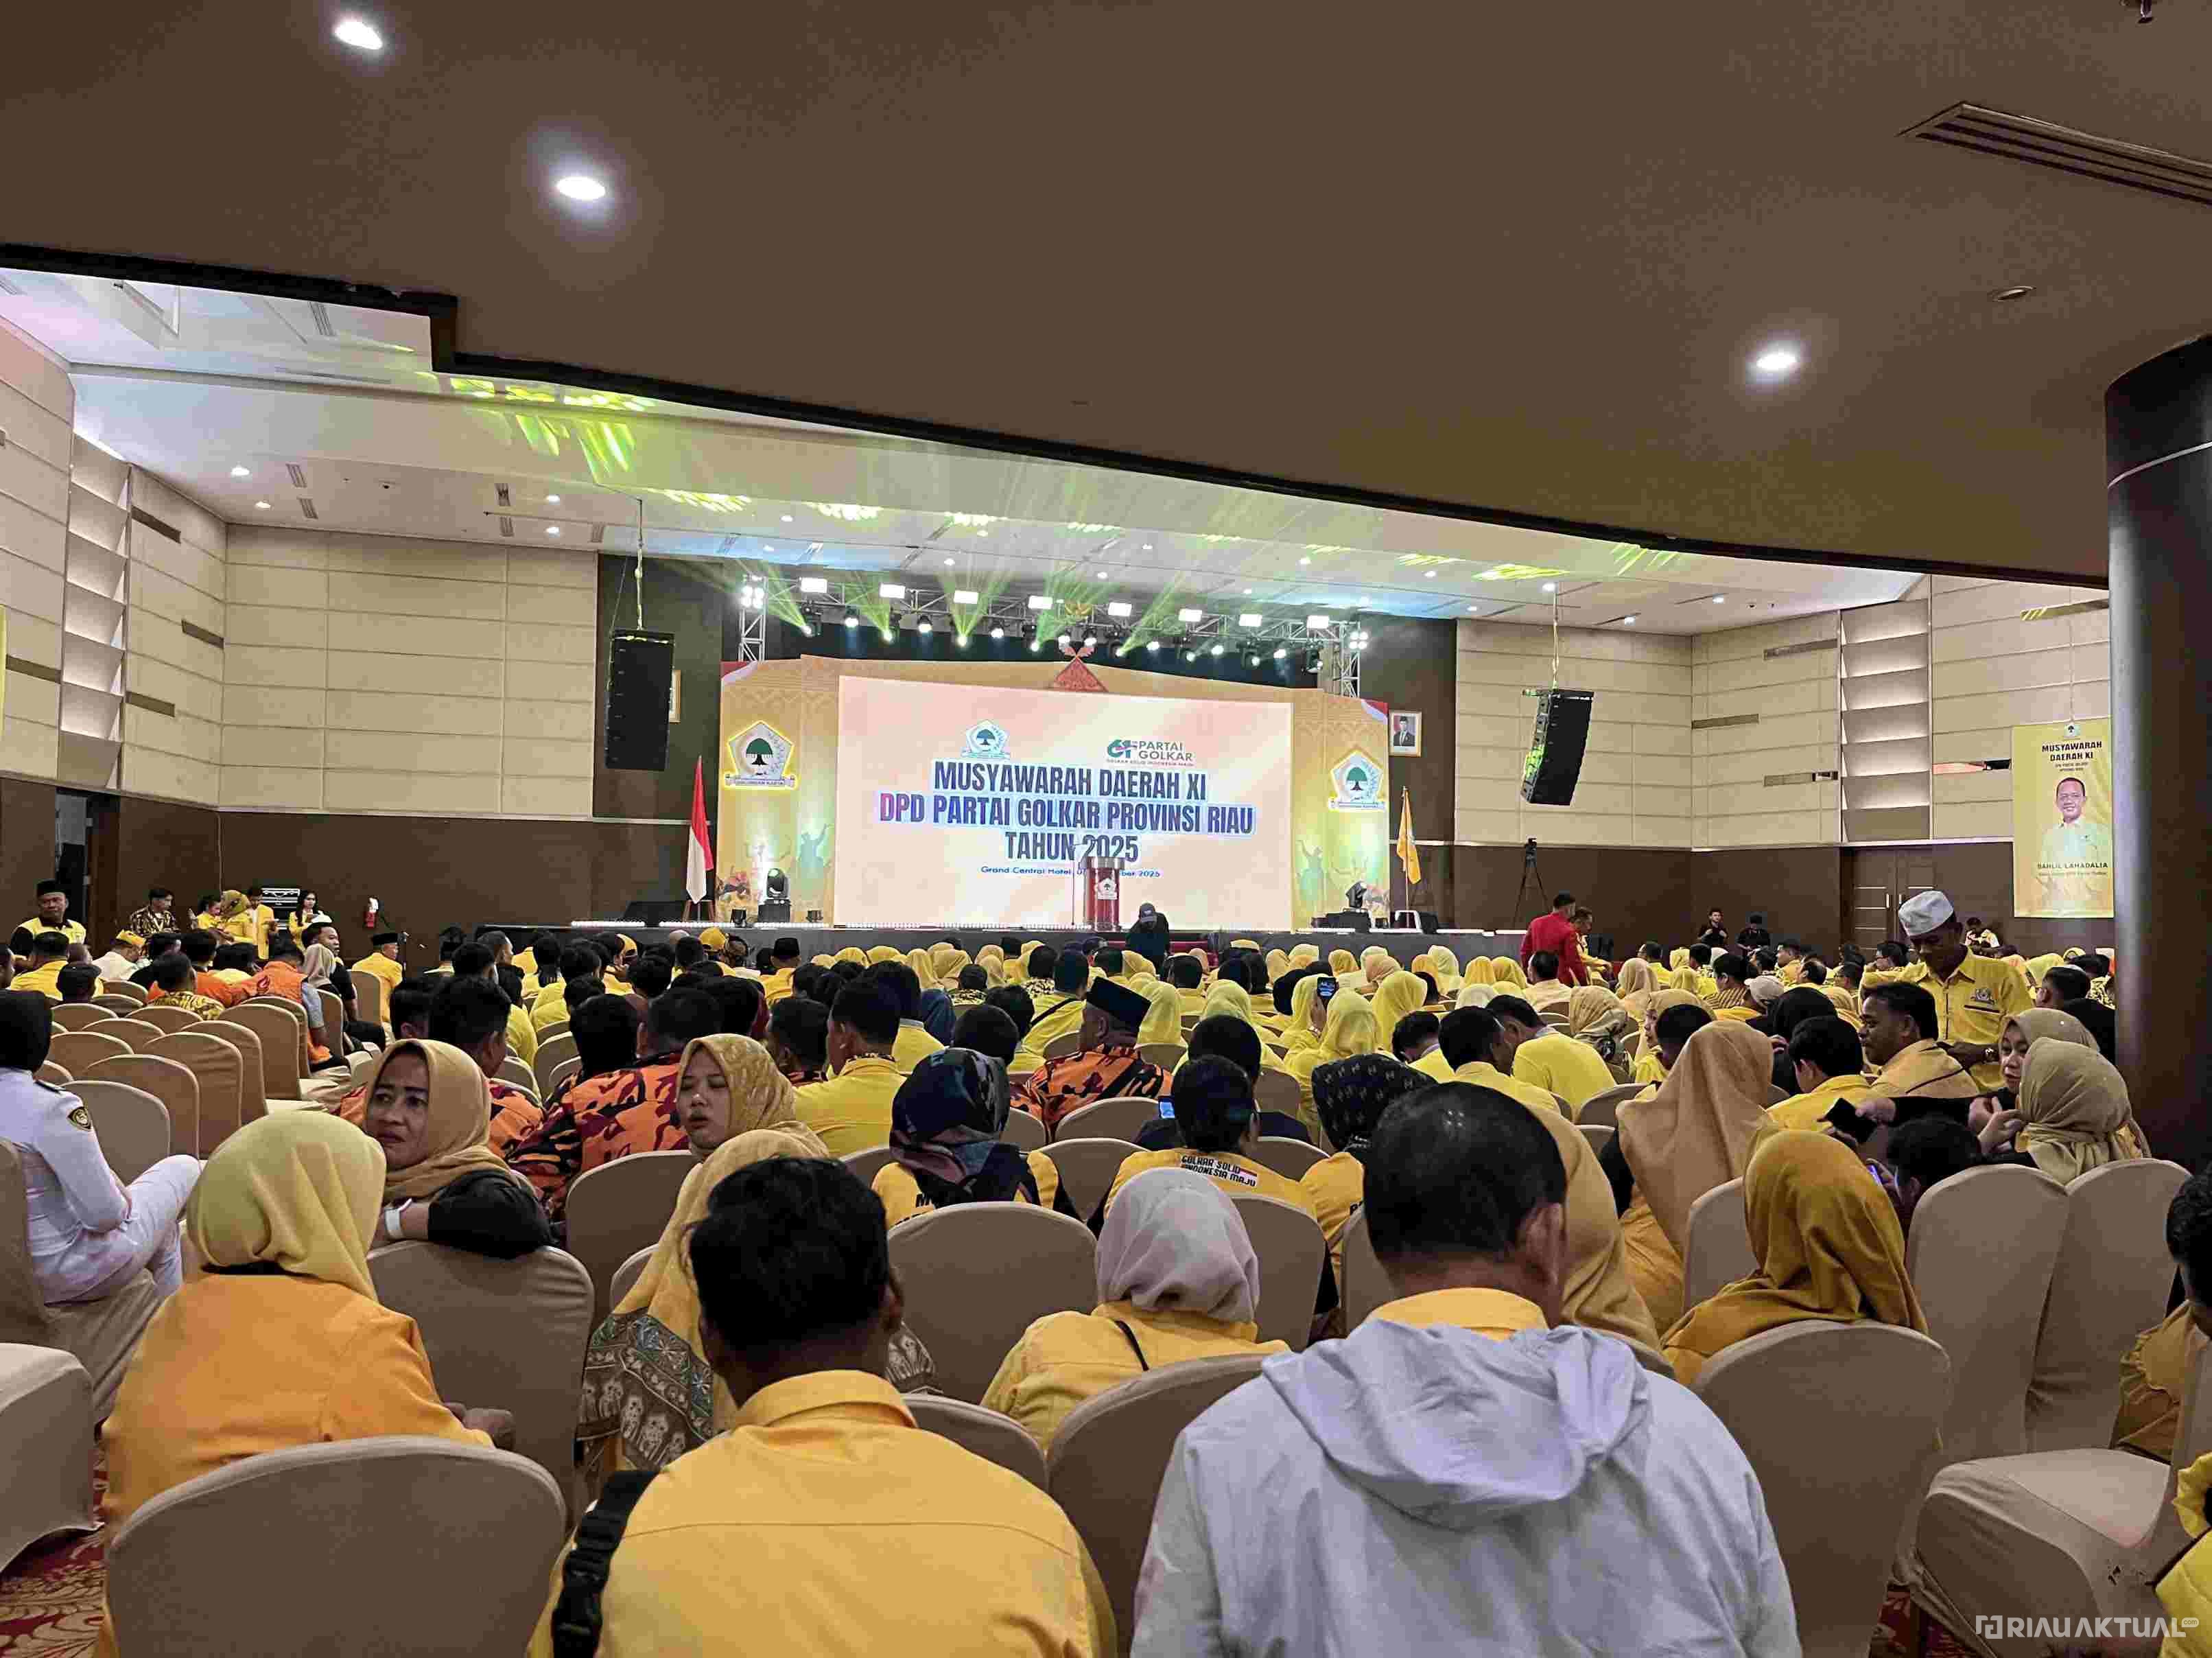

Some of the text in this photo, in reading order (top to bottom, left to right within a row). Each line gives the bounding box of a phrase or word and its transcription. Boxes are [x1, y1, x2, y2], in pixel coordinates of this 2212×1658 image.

[1139, 740, 1184, 751] PARTAI
[2042, 741, 2102, 752] MUSYAWARAH
[1139, 750, 1194, 761] GOLKAR
[934, 760, 1206, 800] MUSYAWARAH DAERAH XI
[880, 792, 1253, 834] DPD PARTAI GOLKAR PROVINSI RIAU
[1005, 832, 1138, 863] TAHUN 2025
[1181, 1155, 1240, 1174] GOLKAR SOLID
[1229, 1174, 1256, 1187] MAJU
